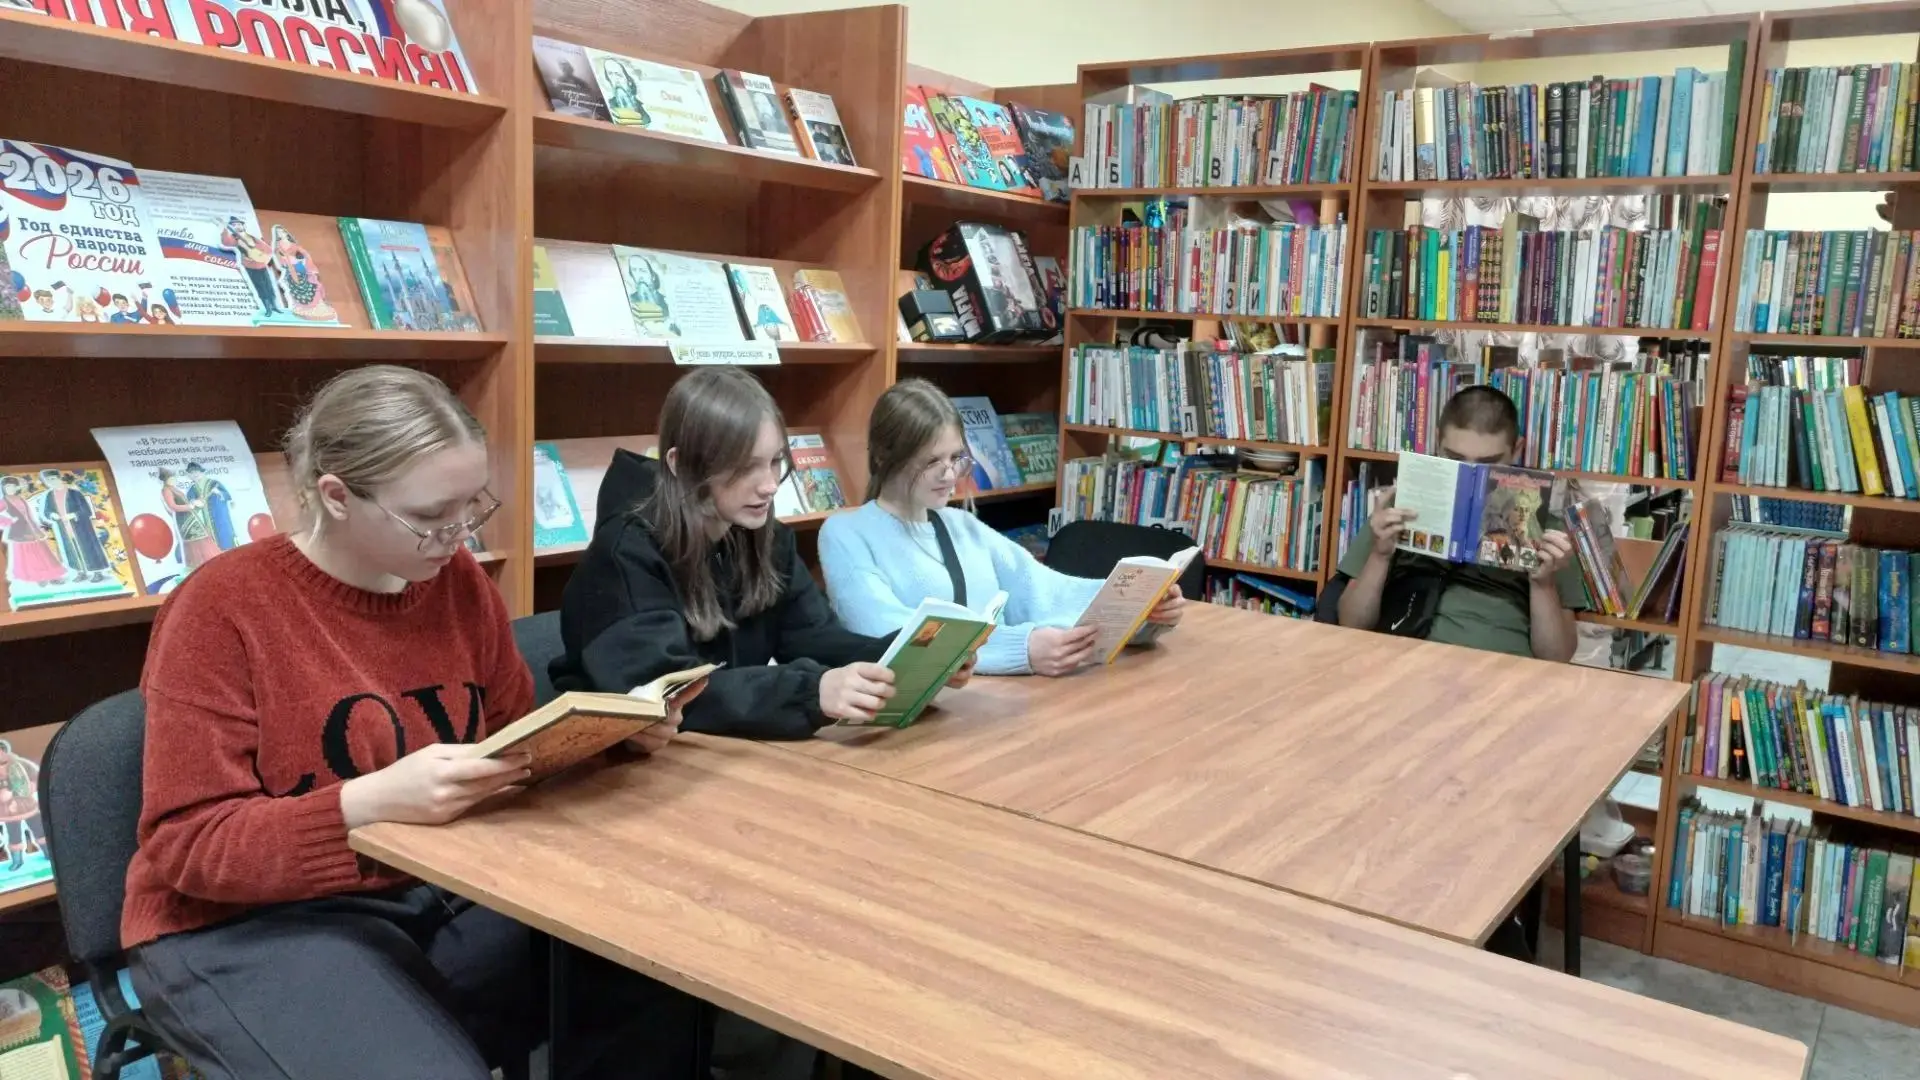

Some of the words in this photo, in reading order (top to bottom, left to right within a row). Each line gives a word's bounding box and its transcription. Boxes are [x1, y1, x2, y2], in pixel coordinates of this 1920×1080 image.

[1072, 163, 1081, 184] А
[1110, 162, 1119, 183] Б
[1211, 157, 1221, 179] В
[1269, 157, 1279, 179] Г
[1382, 151, 1389, 176] А
[0, 152, 131, 203] 2026
[90, 200, 141, 227] год
[18, 217, 52, 234] Год
[60, 223, 144, 243] единства
[157, 227, 195, 240] нство
[19, 232, 145, 276] России
[75, 238, 147, 256] народов
[1226, 288, 1233, 309] З
[1251, 289, 1259, 310] И
[1281, 290, 1288, 311] К
[1370, 291, 1377, 313] В
[952, 284, 981, 338] MAFIA
[960, 409, 992, 425] ССИЯ
[1184, 412, 1193, 432] П
[128, 445, 201, 456] необъяснимая
[150, 436, 188, 445] России
[190, 435, 212, 443] есть
[130, 459, 180, 468] таящаяся
